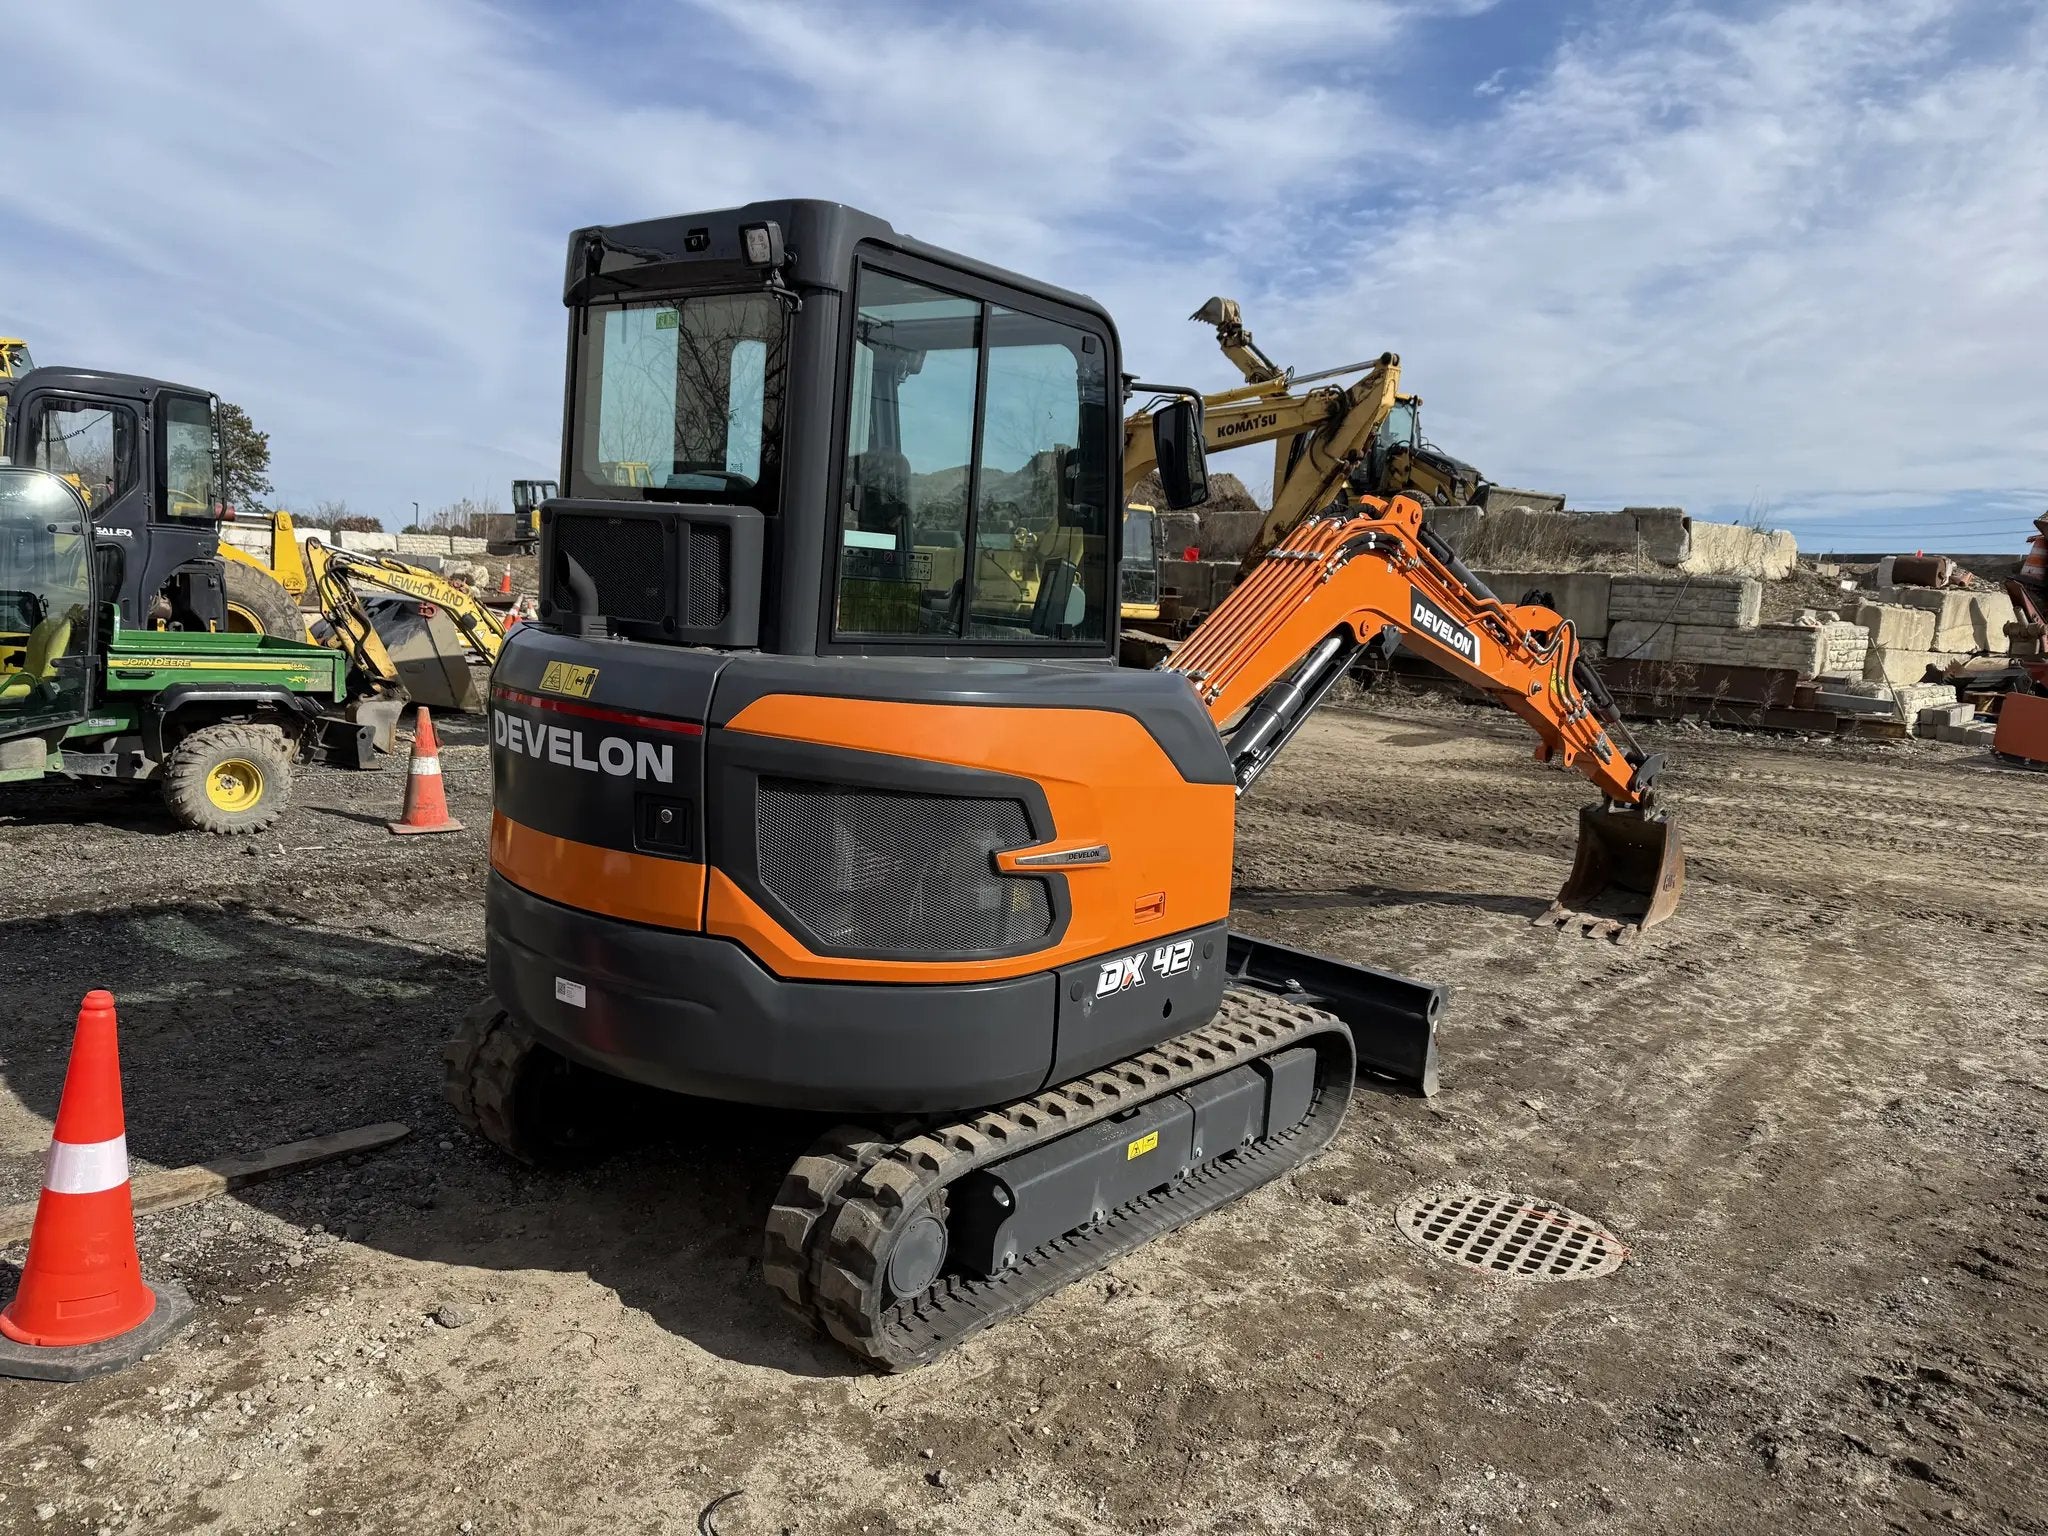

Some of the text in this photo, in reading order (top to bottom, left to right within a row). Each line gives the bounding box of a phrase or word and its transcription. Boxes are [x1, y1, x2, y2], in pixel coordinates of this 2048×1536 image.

[1217, 414, 1277, 437] KOMATSU
[387, 573, 464, 607] NEW HOLLAND
[1413, 603, 1472, 655] DEVELON
[123, 657, 191, 666] JOHN DEERE
[495, 709, 673, 783] DEVELON
[1068, 850, 1100, 859] DEVELON
[1096, 938, 1194, 999] DX 42
